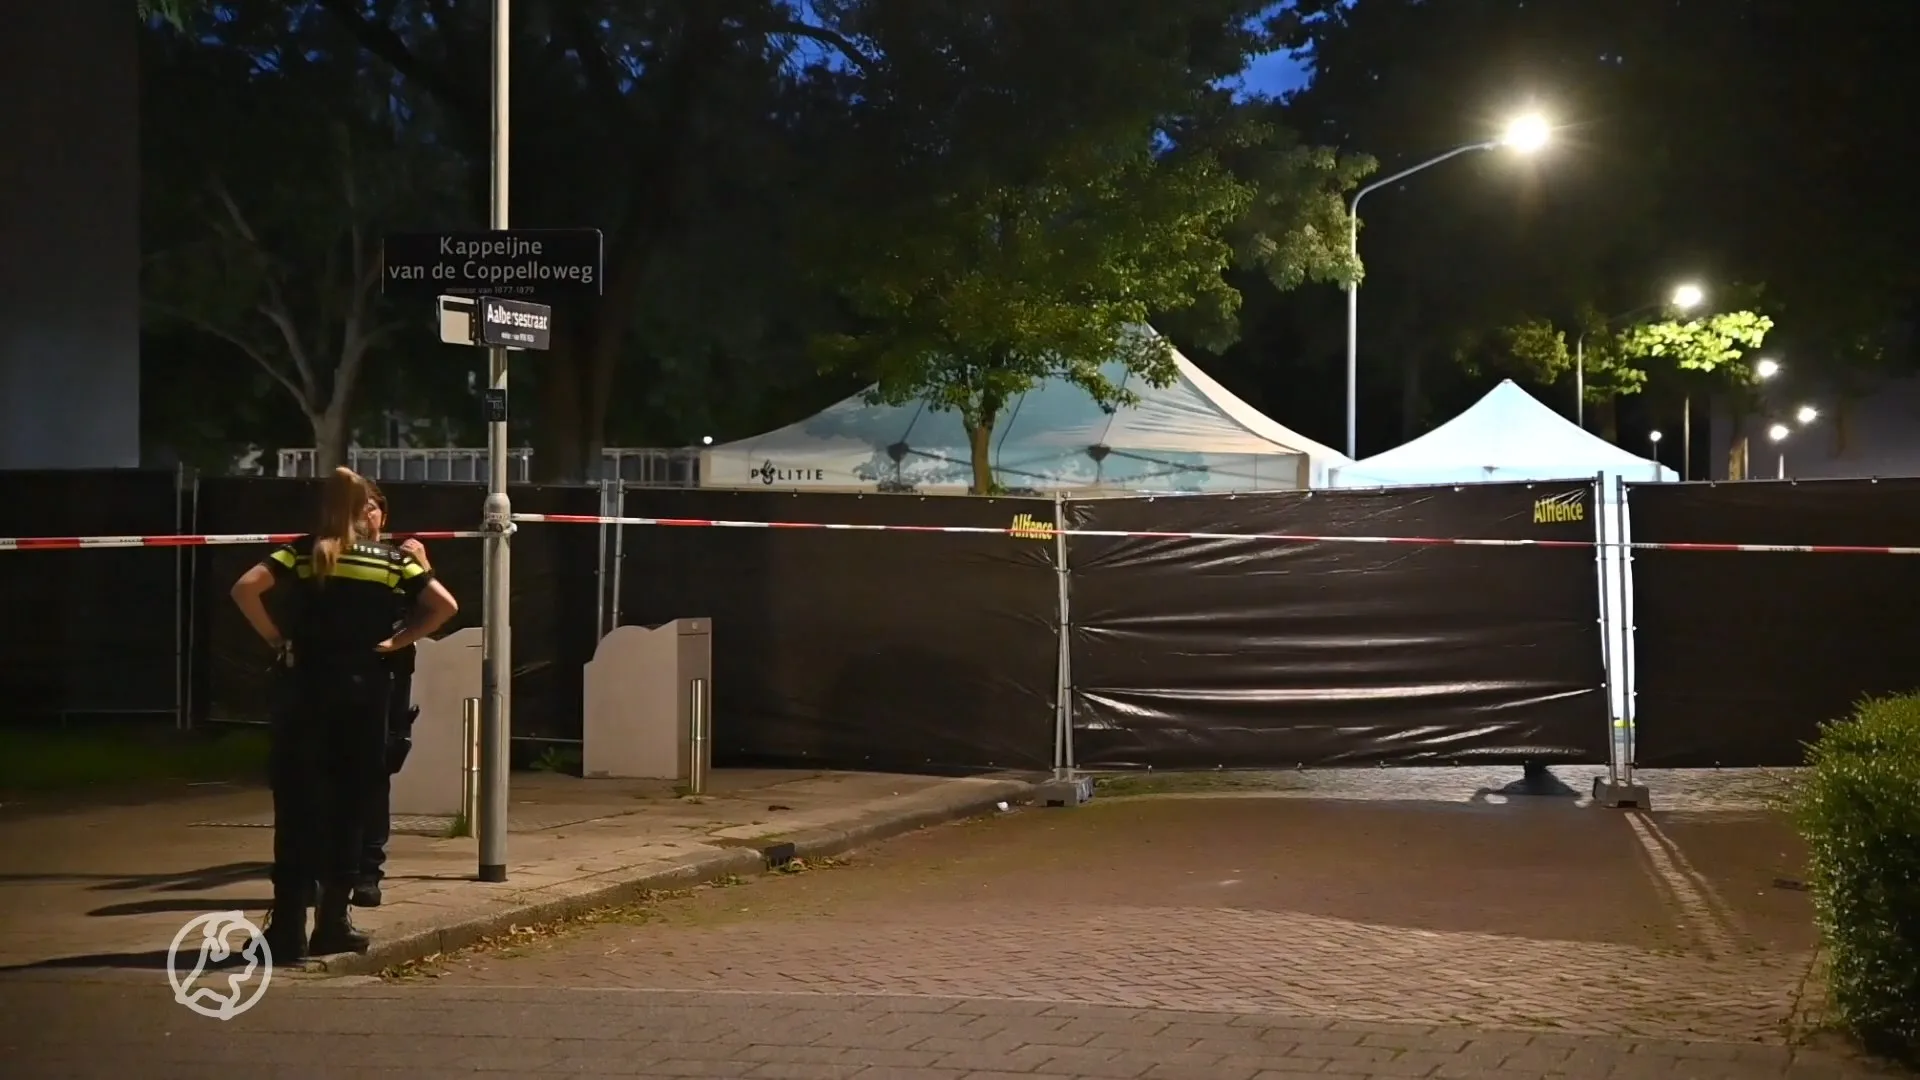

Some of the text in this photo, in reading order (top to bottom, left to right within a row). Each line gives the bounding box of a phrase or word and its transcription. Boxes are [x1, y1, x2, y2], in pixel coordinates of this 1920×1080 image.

[440, 236, 542, 259] Kappeijne
[389, 260, 594, 283] van de Coppelloweg
